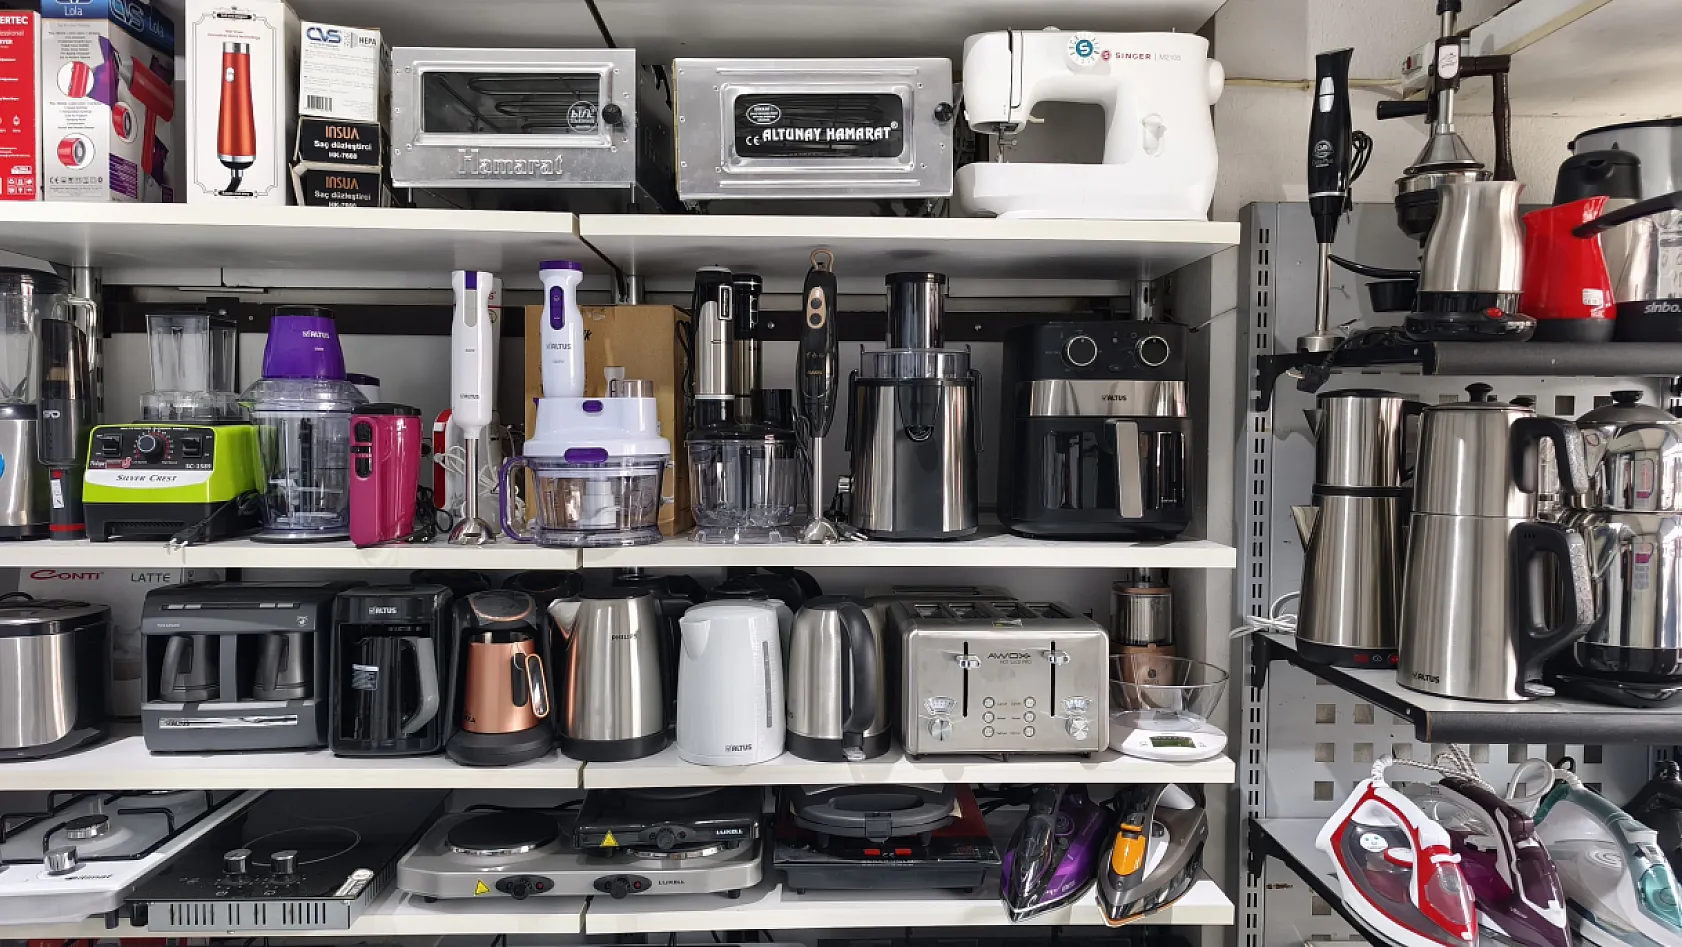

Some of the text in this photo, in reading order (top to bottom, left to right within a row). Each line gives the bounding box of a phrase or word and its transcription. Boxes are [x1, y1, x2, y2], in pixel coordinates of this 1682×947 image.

[64, 5, 83, 16] Lola
[306, 27, 341, 43] CVS
[359, 36, 377, 46] HEPA
[1115, 52, 1151, 60] SINGER
[325, 125, 360, 140] INSUA
[762, 126, 891, 142] ALTUNAY HAMARAT
[313, 140, 330, 149] Saç
[457, 148, 563, 175] Hamarat
[325, 176, 359, 190] INSUA
[314, 190, 330, 199] Saç
[149, 474, 177, 482] CREST
[30, 569, 100, 581] CONTI
[131, 572, 171, 583] LATTE
[375, 606, 397, 614] ALTUS
[611, 633, 639, 641] PHILIPS
[1417, 673, 1440, 684] ALTUS
[731, 743, 753, 751] ALTUS
